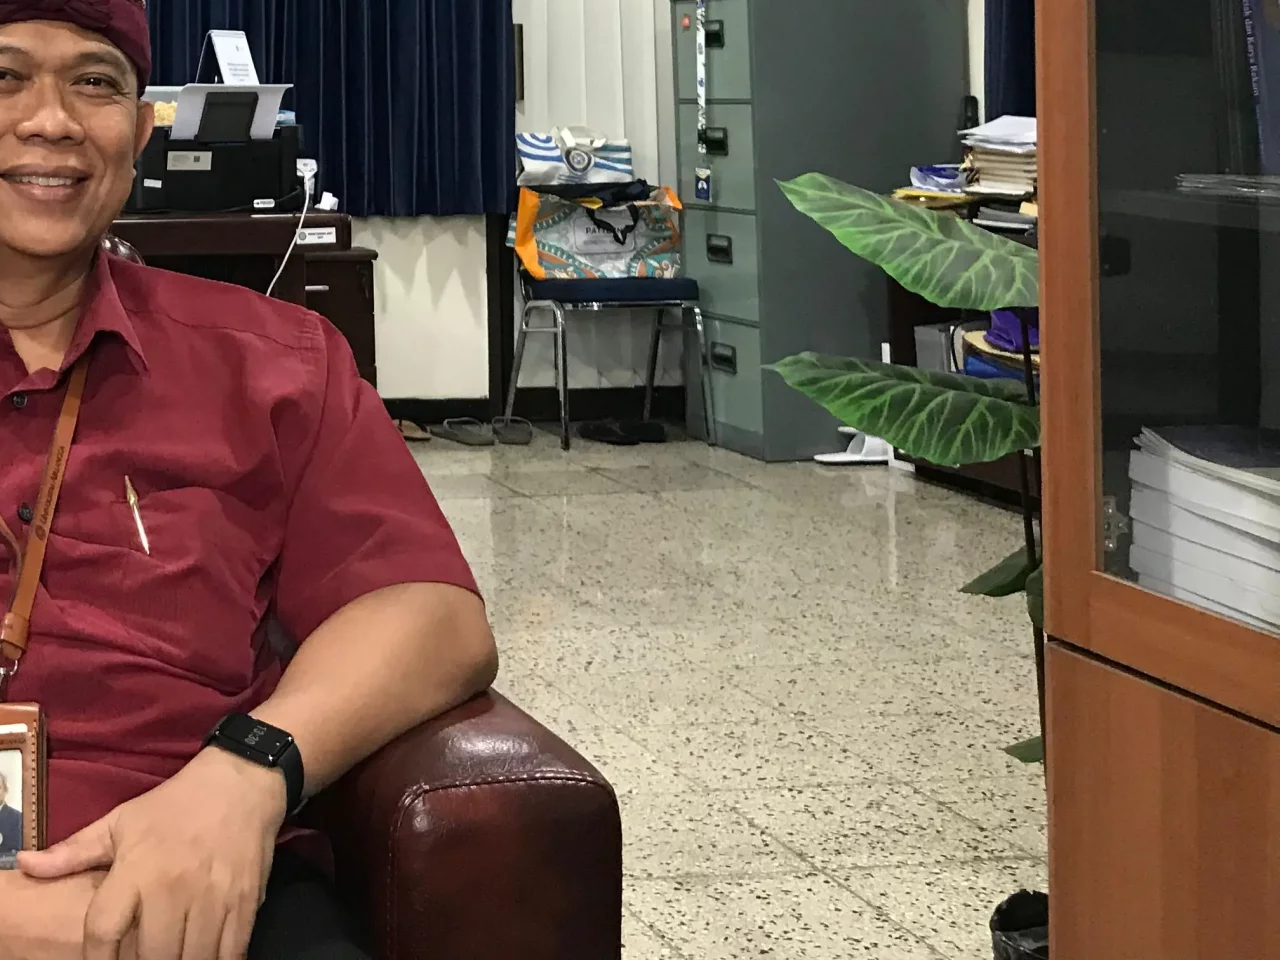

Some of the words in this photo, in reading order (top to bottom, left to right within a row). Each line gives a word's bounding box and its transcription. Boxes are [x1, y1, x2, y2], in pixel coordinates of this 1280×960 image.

[1245, 18, 1253, 35] dan
[1246, 36, 1256, 64] Karya
[1250, 65, 1260, 97] Rekam
